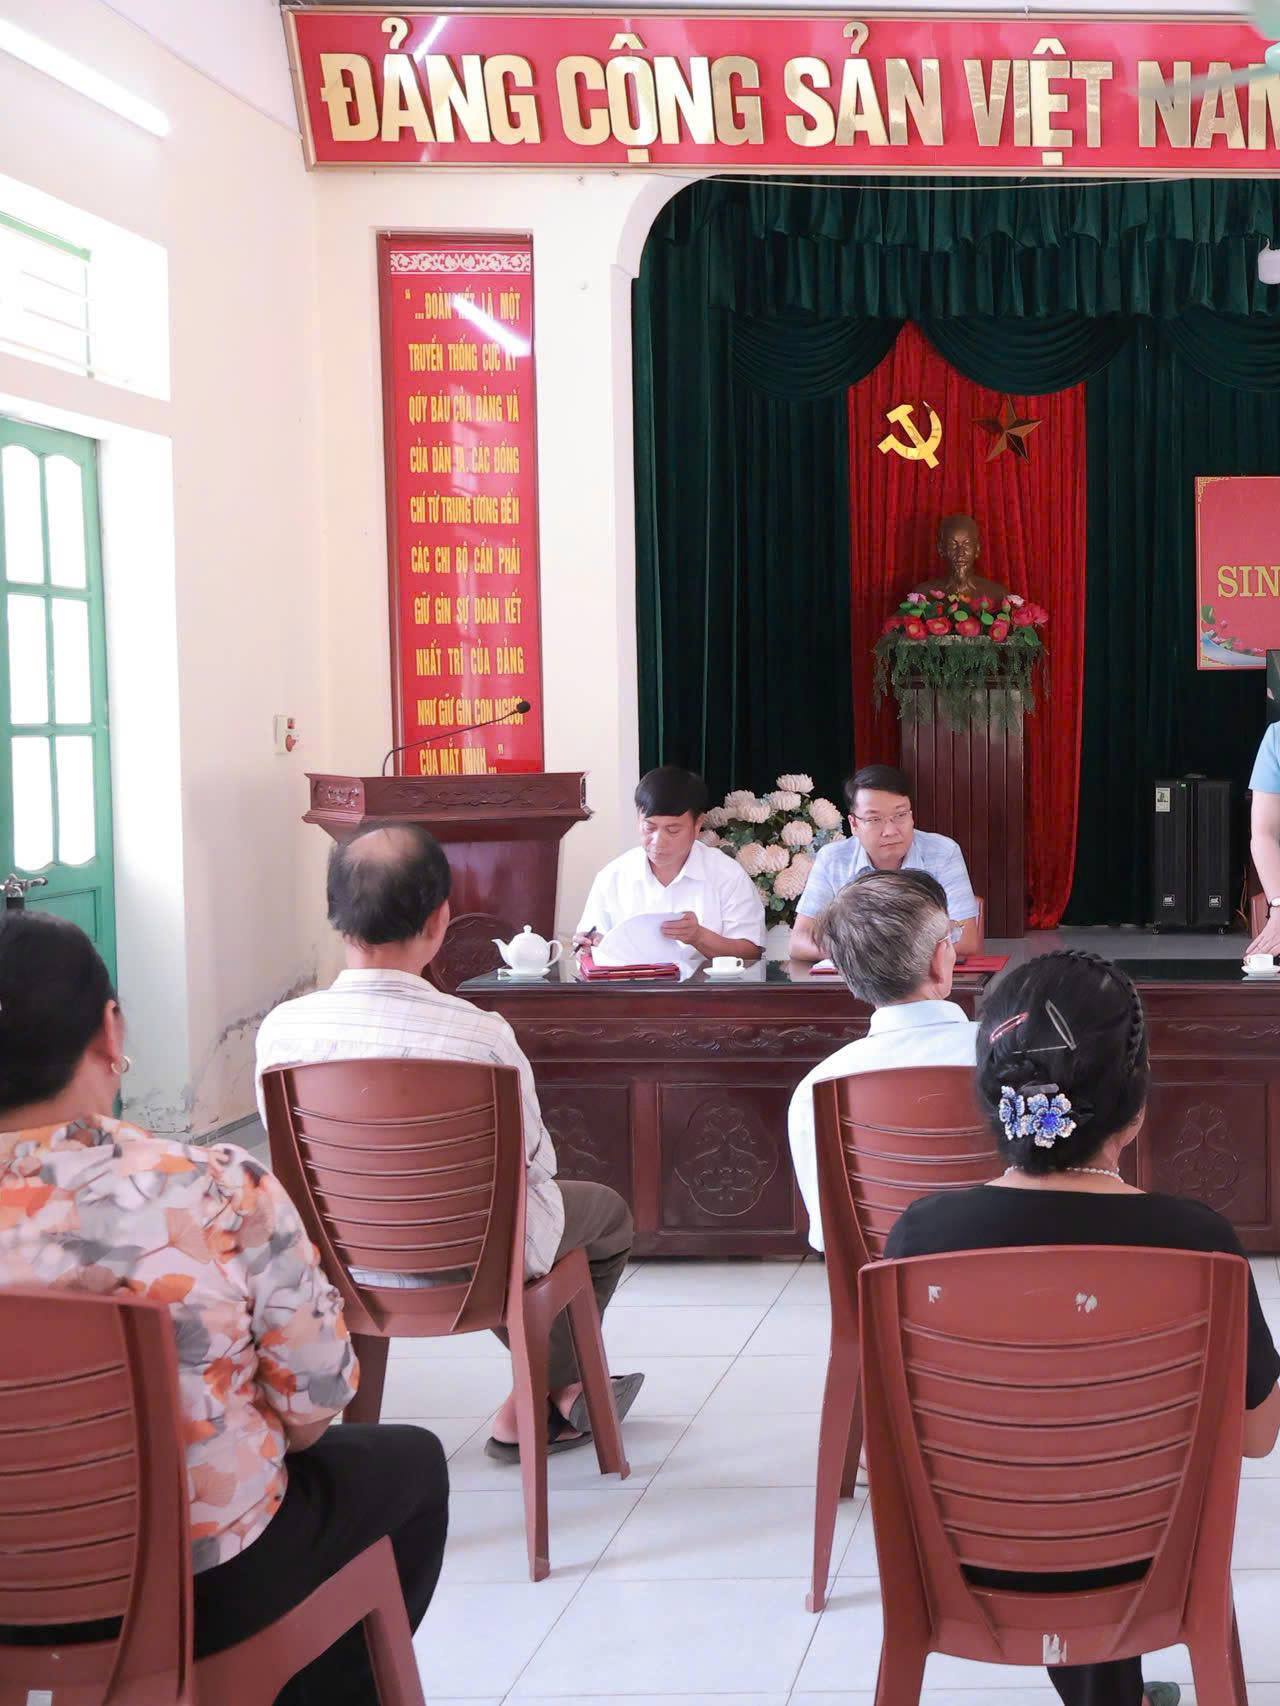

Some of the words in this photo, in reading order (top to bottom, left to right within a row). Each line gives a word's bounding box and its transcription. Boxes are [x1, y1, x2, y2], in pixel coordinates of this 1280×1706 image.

[320, 17, 541, 145] ĐẢNG
[556, 33, 765, 163] CỘNG
[783, 21, 944, 147] SẢN
[963, 38, 1113, 166] VIỆT
[500, 287, 520, 325] MỘT
[447, 334, 478, 371] THỐNG
[482, 343, 501, 376] CỰC
[408, 389, 428, 425] QUÝ
[430, 389, 450, 422] BÁU
[453, 385, 472, 421] CỦA
[475, 385, 503, 422] ĐẢNG
[506, 388, 520, 422] VÀ
[409, 437, 428, 473] CỦA
[431, 440, 451, 473] DÂN
[472, 442, 490, 473] CÁC
[410, 490, 426, 523] CHÍ
[427, 490, 440, 523] TỪ
[441, 496, 472, 523] TRUNG
[473, 495, 499, 523] ƯƠNG
[501, 488, 519, 524] ĐẾN
[411, 540, 430, 573] CÁC
[434, 546, 450, 573] CHI
[456, 541, 468, 579] BỘ
[498, 538, 520, 574] PHẢI
[414, 591, 430, 624] GIỮ
[434, 591, 451, 624] GÌN
[456, 594, 470, 630] SỰ
[474, 591, 499, 624] ĐOÀN
[504, 587, 521, 624] KẾT
[416, 638, 441, 675] NHẤT
[447, 641, 464, 675] TRÍ
[470, 638, 490, 674] CỦA
[496, 637, 525, 674] ĐẢNG
[417, 697, 437, 726] NHƯ
[456, 692, 472, 726] GÌN
[474, 699, 492, 726] CON
[420, 741, 440, 775] CỦA
